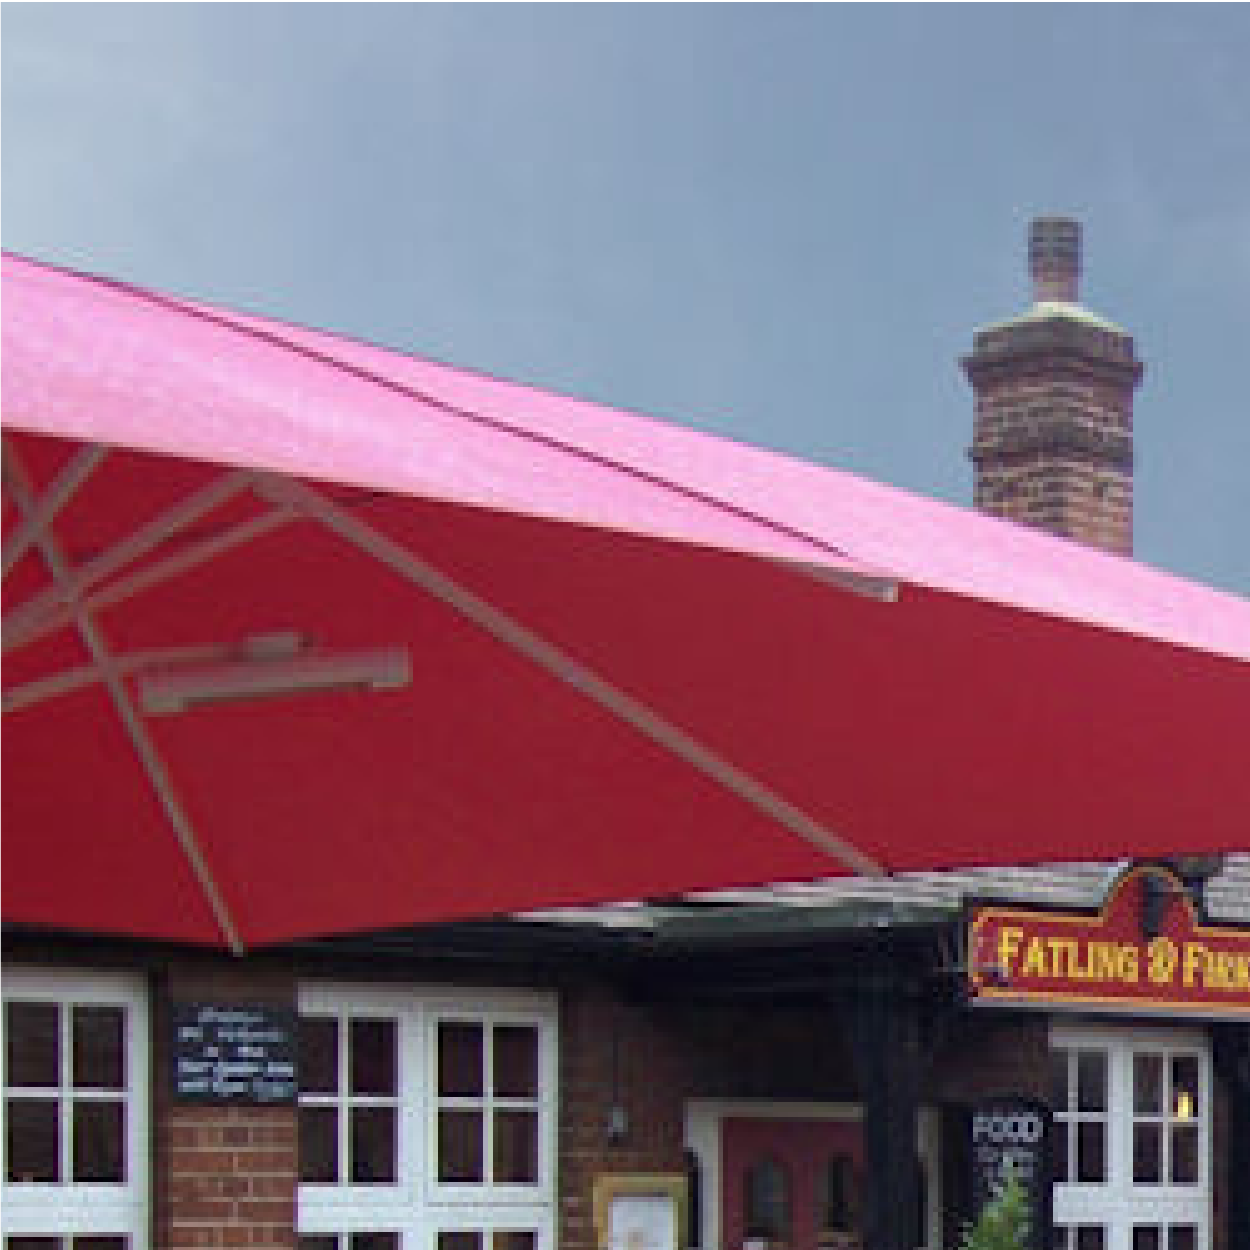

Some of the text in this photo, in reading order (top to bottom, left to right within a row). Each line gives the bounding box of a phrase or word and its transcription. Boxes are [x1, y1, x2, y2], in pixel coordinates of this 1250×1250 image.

[997, 926, 1140, 984] FATLING
[1146, 939, 1180, 985] &
[973, 1111, 1044, 1143] FOOD
